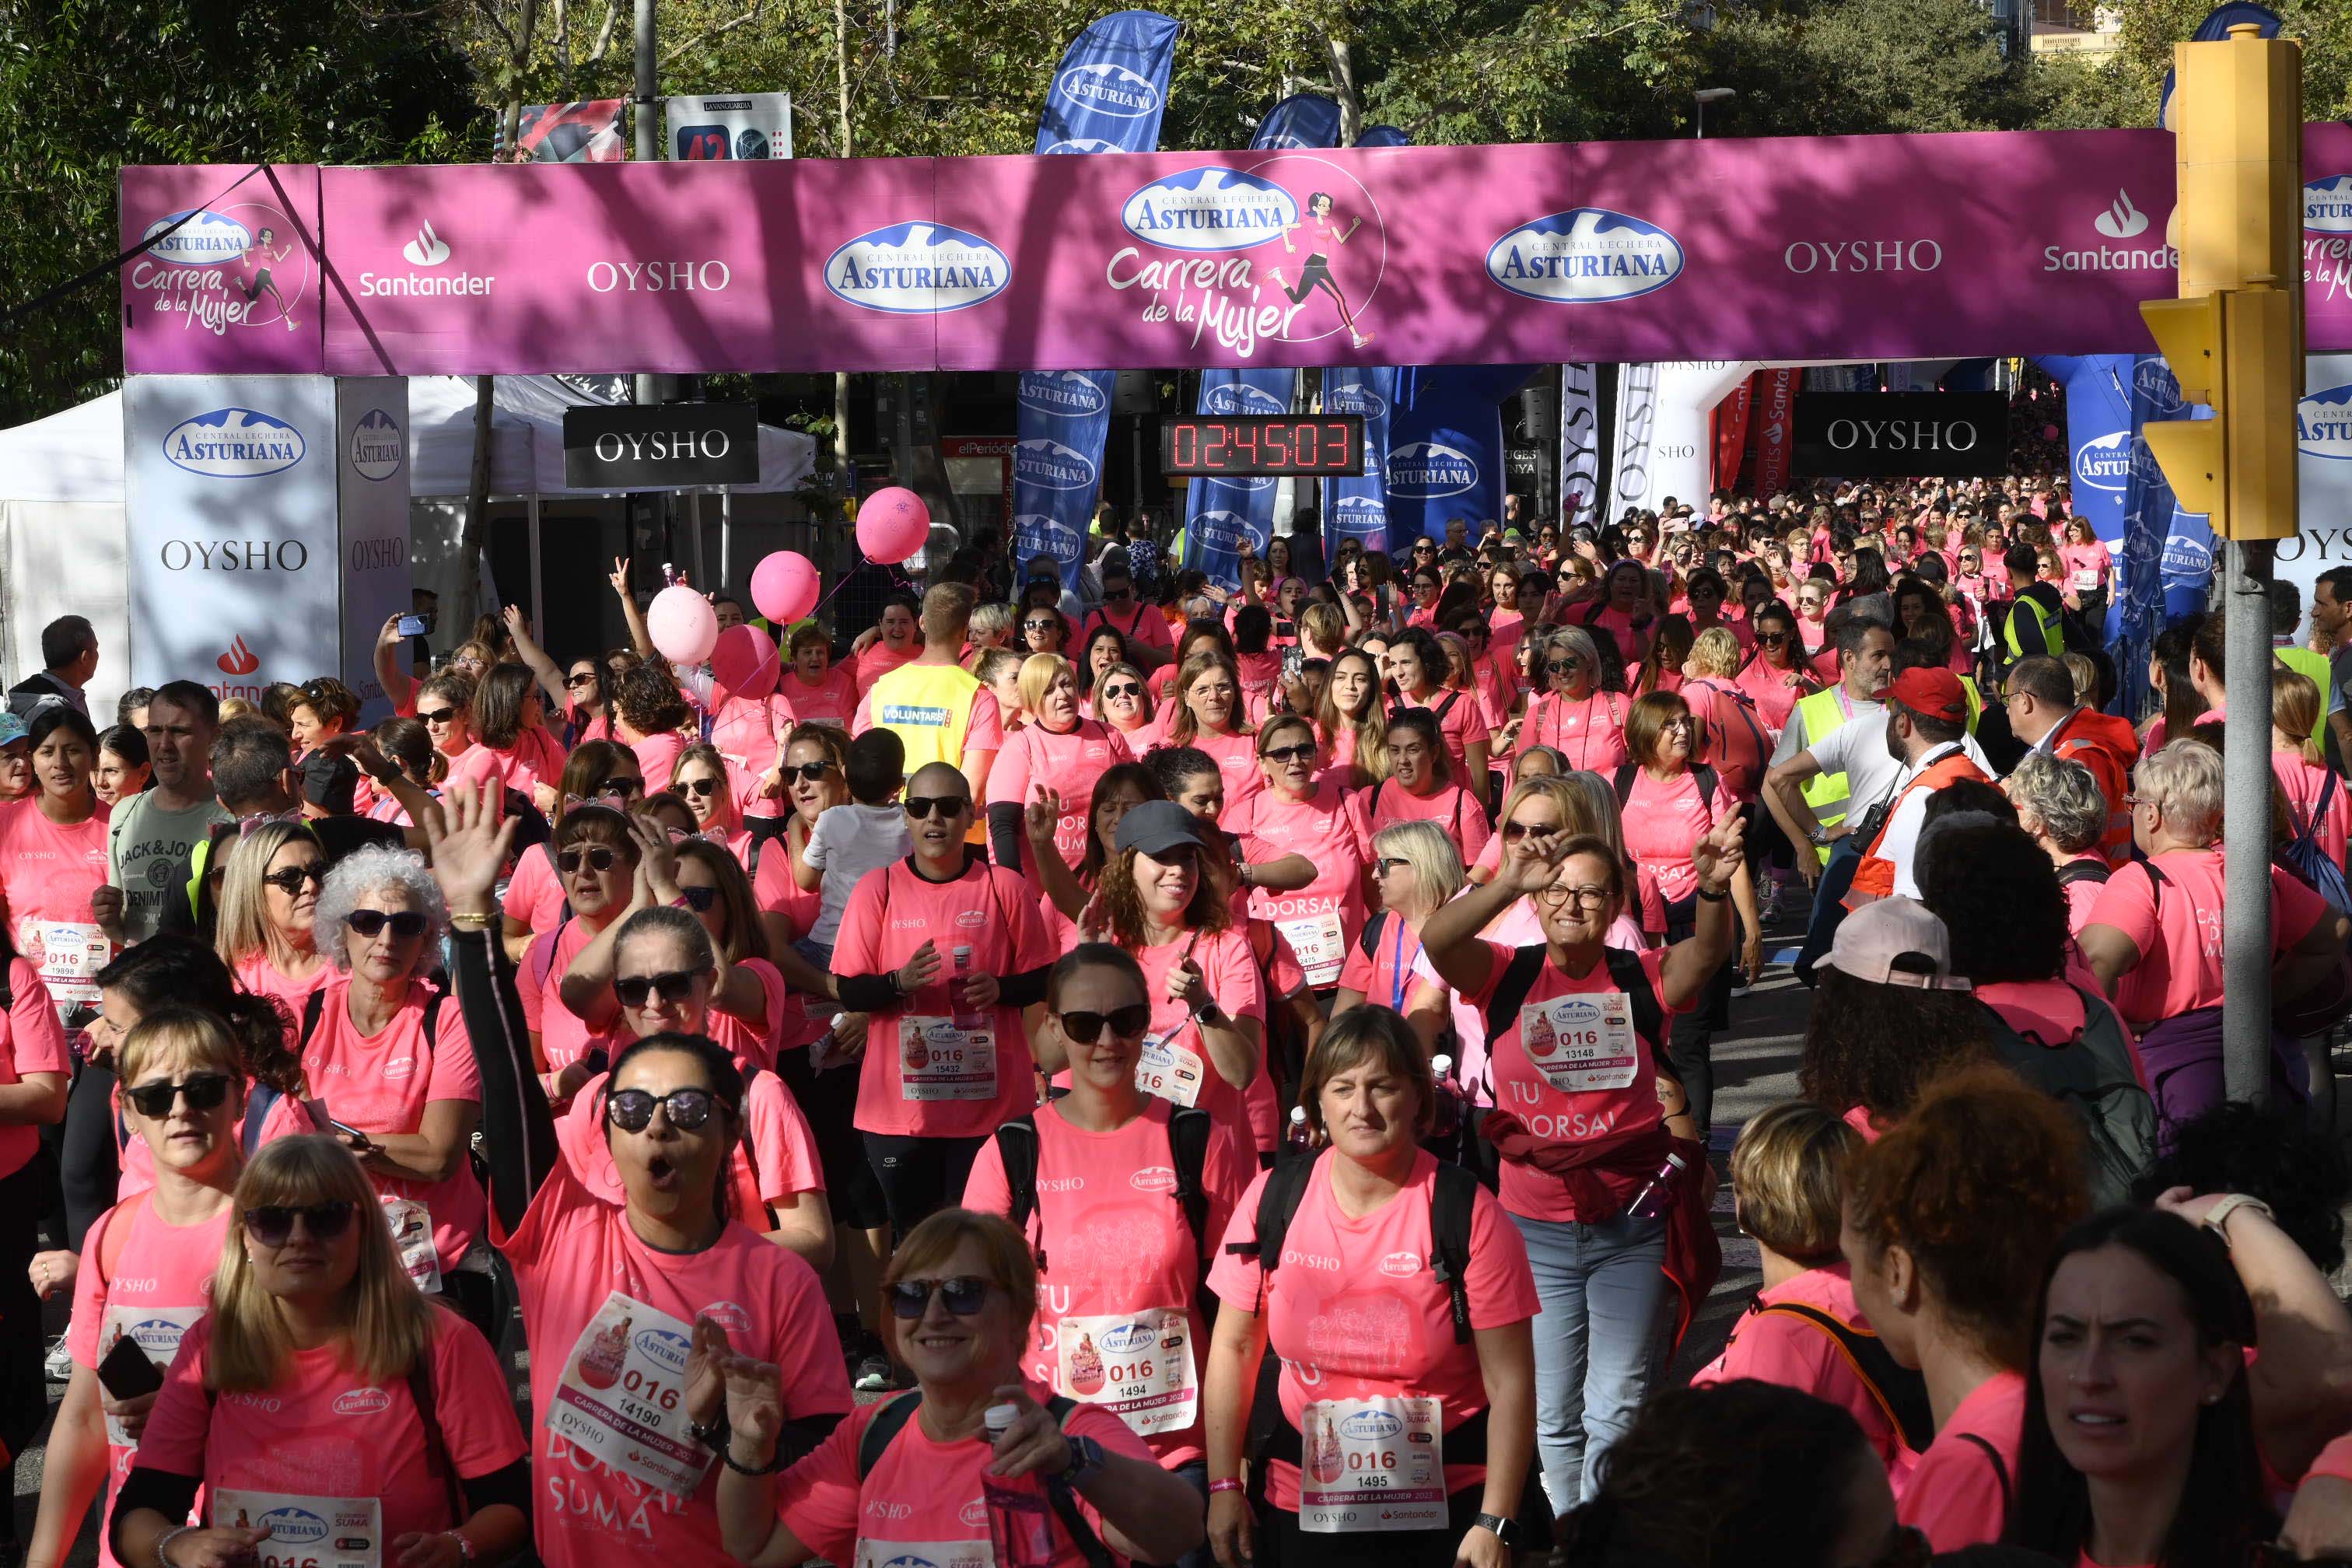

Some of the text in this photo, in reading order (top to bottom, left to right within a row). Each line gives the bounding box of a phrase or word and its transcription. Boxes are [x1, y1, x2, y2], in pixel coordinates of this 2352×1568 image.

[1066, 75, 1150, 109] ASTURIANA
[1085, 76, 1116, 87] CENTRAL
[1162, 195, 1279, 205] CENTRAL LECHERA
[2304, 204, 2352, 218] STUR
[1136, 199, 1284, 230] ASTURIANA
[868, 252, 989, 261] CENTRAL LECHERA
[1532, 240, 1662, 251] CENTRAL LECHERA
[1784, 239, 1942, 273] OYSHO
[1107, 247, 1251, 290] Carrera
[1501, 244, 1669, 279] ASTURIANA
[2044, 244, 2178, 272] Santande
[132, 261, 223, 290] Carrera
[587, 261, 730, 292] OYSHO
[838, 256, 996, 289] ASTURIANA
[2316, 261, 2329, 282] la
[360, 271, 494, 296] Santander
[155, 289, 257, 335] de la Mujer
[1142, 285, 1306, 358] de la Mujer
[1770, 367, 1788, 420] Santa
[1566, 363, 1597, 513] OYSH
[1619, 363, 1653, 502] OYSH
[1828, 419, 1977, 451] OYSHO
[2298, 413, 2352, 441] ASTU
[174, 434, 295, 460] ASTURIANA
[355, 436, 399, 462] ASTURIANA
[595, 429, 730, 461] OYSHO
[958, 442, 1013, 454] elPeriódi
[1174, 425, 1347, 467] 02:45:03
[1657, 445, 1694, 458] SHO
[1018, 459, 1088, 482] STURIANA
[1385, 464, 1471, 485] ASTURIANA
[2081, 454, 2129, 476] ASTU
[161, 540, 308, 571] OYSHO
[352, 537, 404, 572] OYSHO
[1017, 535, 1075, 557] TURIANA
[2273, 528, 2352, 562] OYS
[1059, 800, 1069, 811] U
[121, 840, 163, 869] JACK &
[1054, 836, 1086, 850] UM
[49, 953, 79, 964] 016
[1294, 943, 1319, 956] 016
[1560, 1031, 1598, 1045] 016
[932, 1050, 963, 1061] 016
[1566, 1049, 1594, 1058] 13148
[309, 1056, 351, 1077] OSHO
[1597, 1073, 1629, 1081] Santander
[1510, 1080, 1539, 1104] TU
[1285, 1251, 1339, 1271] OYSHO
[115, 1278, 156, 1293] YSHO
[639, 1334, 685, 1366] ASTURIA
[1110, 1360, 1153, 1382] 016
[624, 1370, 680, 1410] 016
[1120, 1384, 1146, 1398] 1494
[1145, 1397, 1167, 1407] MUJER
[1169, 1392, 1185, 1401] 2023
[574, 1395, 674, 1452] CARRERA DE LA MUJER
[620, 1399, 661, 1426] 14190
[1152, 1409, 1188, 1423] Santande
[562, 1412, 604, 1444] OYSHO
[1345, 1423, 1397, 1434] ASTURIANA
[1348, 1451, 1397, 1470] 016
[1357, 1476, 1388, 1487] 1495
[550, 1476, 652, 1538] SUMA
[1314, 1512, 1356, 1523] OYSHO
[1393, 1510, 1437, 1519] Santander
[336, 1518, 368, 1528] SUMA
